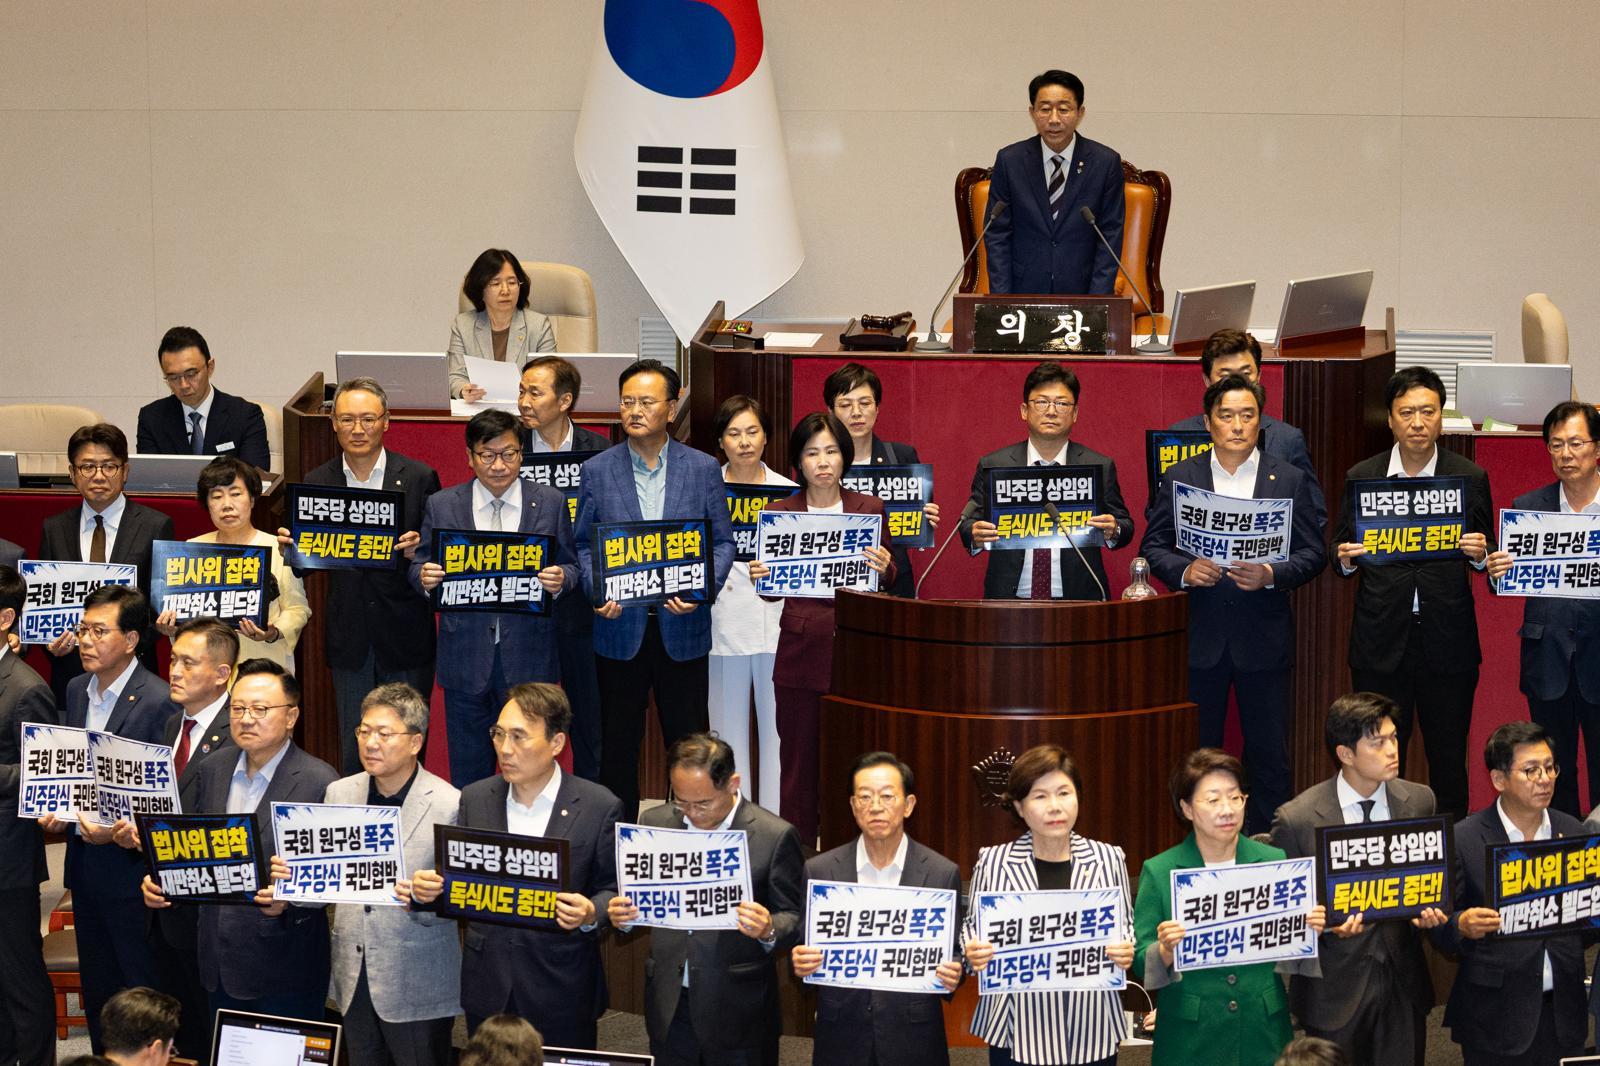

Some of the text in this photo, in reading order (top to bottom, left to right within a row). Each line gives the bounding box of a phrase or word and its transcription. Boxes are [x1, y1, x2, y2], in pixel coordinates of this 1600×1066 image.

[520, 465, 551, 486] 주당
[839, 477, 923, 500] 주당 상임위
[996, 477, 1093, 503] 민주당 상임위
[298, 497, 394, 526] 민주당 상임위
[1181, 504, 1286, 532] 국회 원구성 폭주
[1360, 489, 1462, 517] 민주당 상임위
[888, 511, 922, 536] 중단!
[998, 513, 1053, 539] 독식시도
[298, 532, 394, 560] 독식시도 중단!
[605, 533, 661, 568] 법사위
[666, 531, 701, 560] 집착
[765, 534, 796, 557] 국회
[800, 530, 841, 555] 원구성
[843, 528, 874, 553] 폭주
[1180, 530, 1283, 561] 민주당식 국민협박
[1363, 524, 1462, 555] 독식시도 중단!
[1508, 530, 1600, 556] 국회 원구성 폭
[166, 556, 260, 586] 법사위 집착
[445, 543, 543, 573] 법사위 집착
[440, 576, 543, 605] 재판취소 빌드업
[605, 563, 705, 601] 재판취소 빌드업
[1504, 562, 1600, 590] 민주당식 국민협
[27, 583, 56, 606] 국회
[162, 590, 260, 619] 재판취소 빌드업
[28, 749, 52, 775] 국회
[56, 748, 85, 774] 원구성
[97, 756, 113, 783] 국회
[115, 759, 142, 785] 원구성
[144, 761, 169, 789] 폭주
[24, 783, 98, 812] 민주당식 국민협
[99, 791, 131, 821] 민주당식
[151, 827, 248, 862] 법사위 집착
[283, 823, 395, 855] 국회 원구성 폭주
[1330, 830, 1443, 870] 민주당 상임위
[448, 840, 558, 880] 민주당 상임위
[625, 847, 740, 880] 국회 원구성 폭주
[1501, 846, 1600, 897] 법사위 집착
[158, 863, 256, 896] 재판취소 빌드업
[282, 860, 397, 894] 민주당식 국민협박
[449, 880, 556, 918] 독식시도 중단!
[685, 885, 743, 917] 국민협박
[1184, 875, 1307, 924] 국회 원구성 폭주
[1333, 871, 1443, 914] 독식시도 중단!
[817, 907, 946, 937] 국회 원구성 폭주
[988, 905, 1115, 947] 국회 원구성 폭주
[1498, 895, 1559, 935] 재판취소
[1182, 914, 1307, 963] 민주당식 국민협박
[882, 947, 943, 977] 국민협박
[986, 953, 1050, 988] 민주당식
